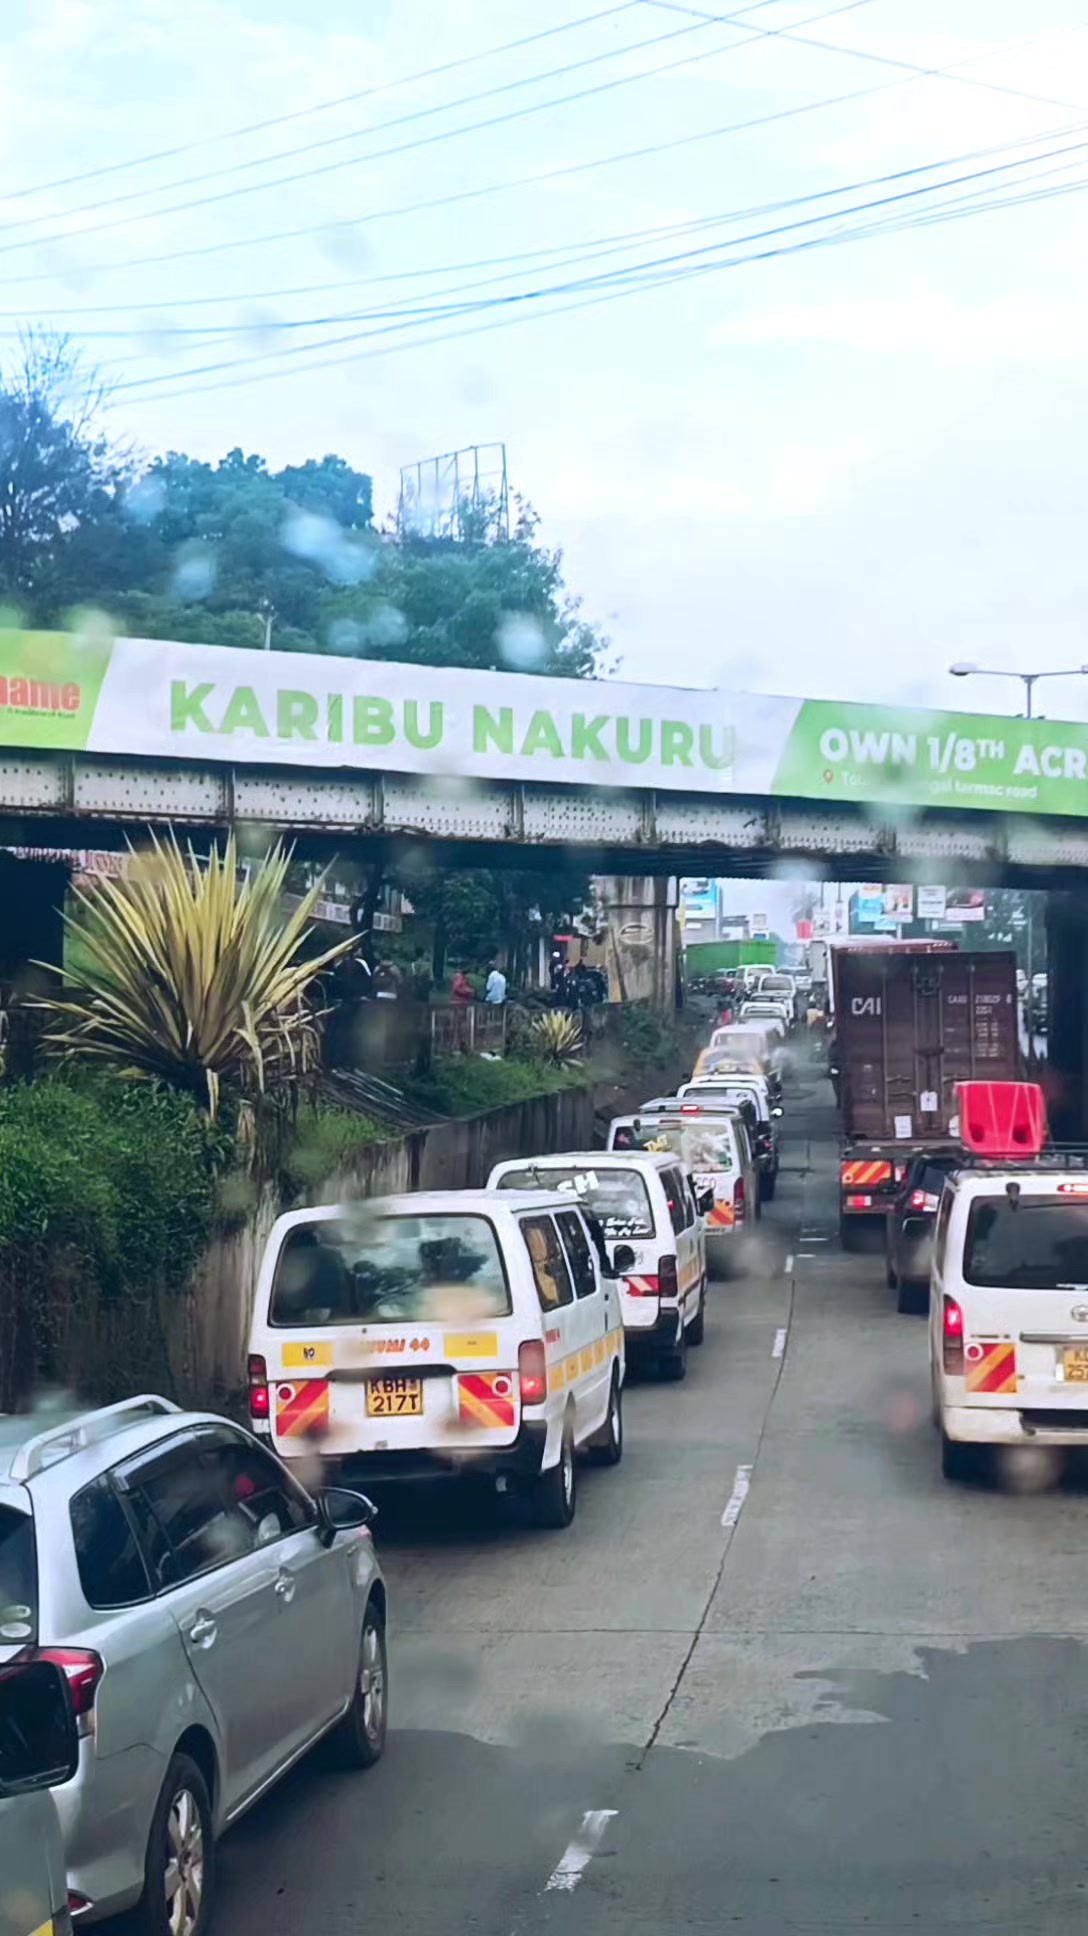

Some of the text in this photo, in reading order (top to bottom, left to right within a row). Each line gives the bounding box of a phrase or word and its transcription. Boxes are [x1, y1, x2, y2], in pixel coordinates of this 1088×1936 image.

[170, 680, 735, 769] KARIBU NAKURU
[820, 728, 917, 764] OWN
[852, 997, 881, 1015] CAI
[370, 1379, 406, 1394] KBH
[373, 1394, 418, 1412] 217T
